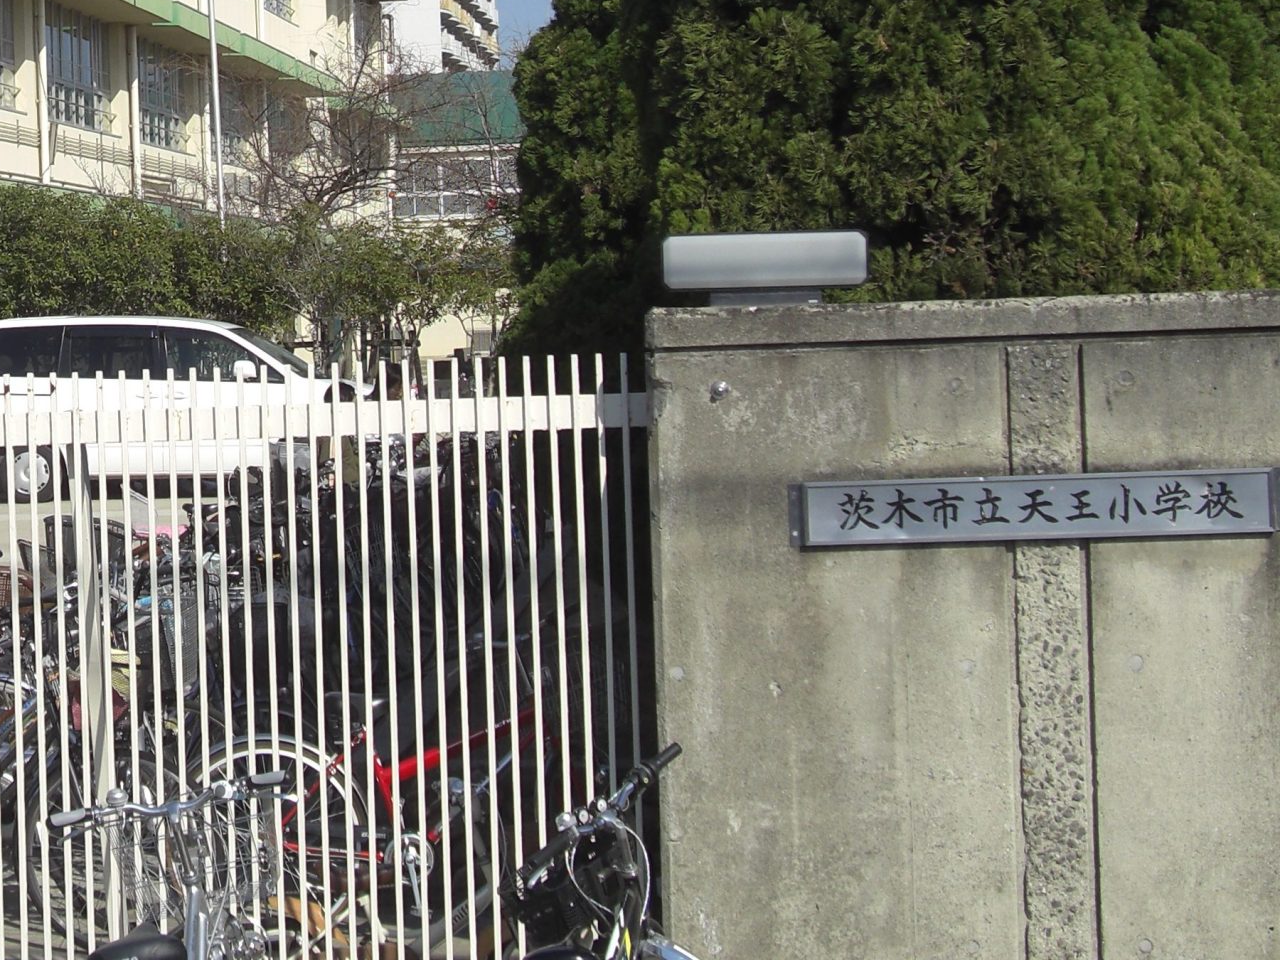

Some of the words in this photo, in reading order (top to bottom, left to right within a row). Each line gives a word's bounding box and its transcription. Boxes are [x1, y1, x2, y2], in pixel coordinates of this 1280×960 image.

[837, 481, 1246, 530] 茨木市立天王小学校
